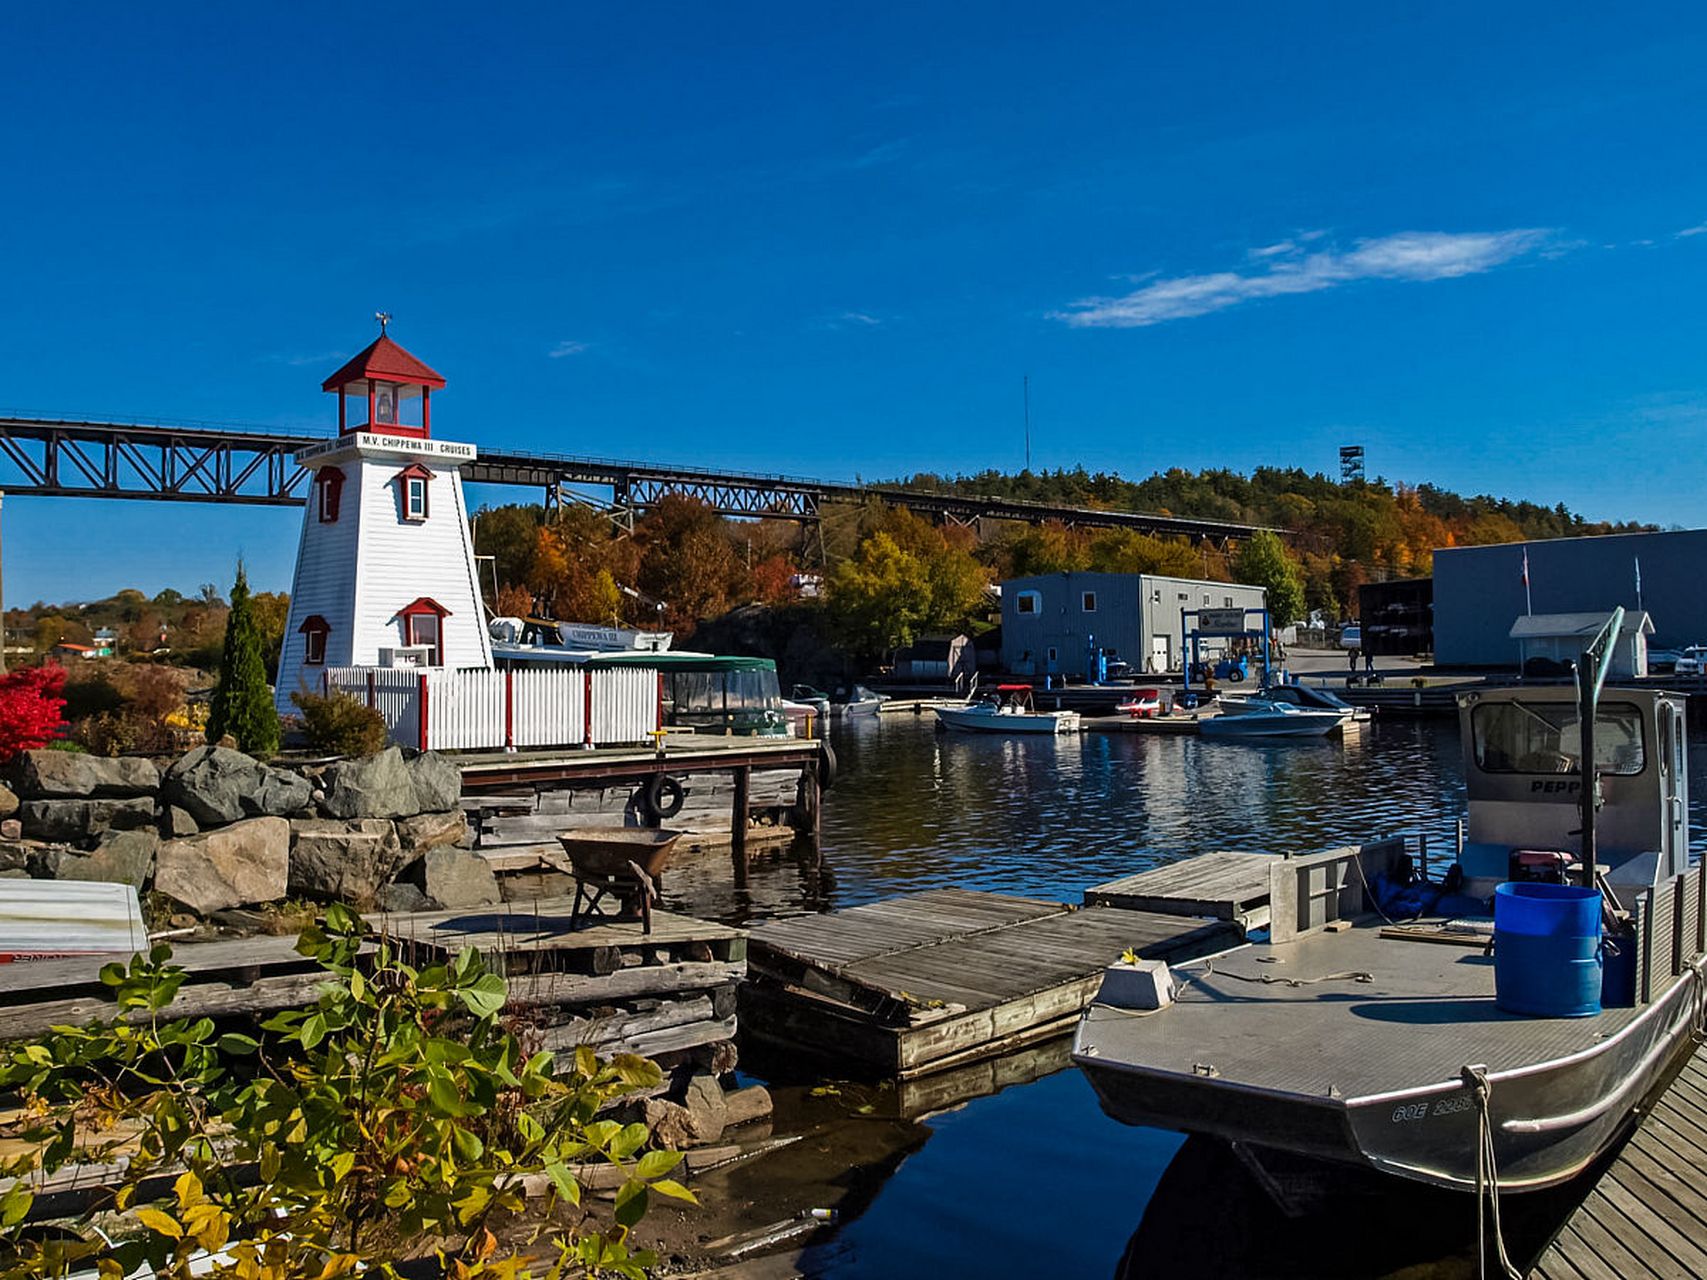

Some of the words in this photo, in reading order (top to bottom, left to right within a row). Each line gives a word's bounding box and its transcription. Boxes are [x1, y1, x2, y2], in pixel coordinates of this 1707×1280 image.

[362, 435, 380, 446] M.V.
[382, 437, 422, 451] CHIPPEWA
[424, 442, 434, 452] III
[440, 444, 471, 456] CRUISES
[404, 654, 422, 663] ICE
[1531, 780, 1582, 794] PEPP
